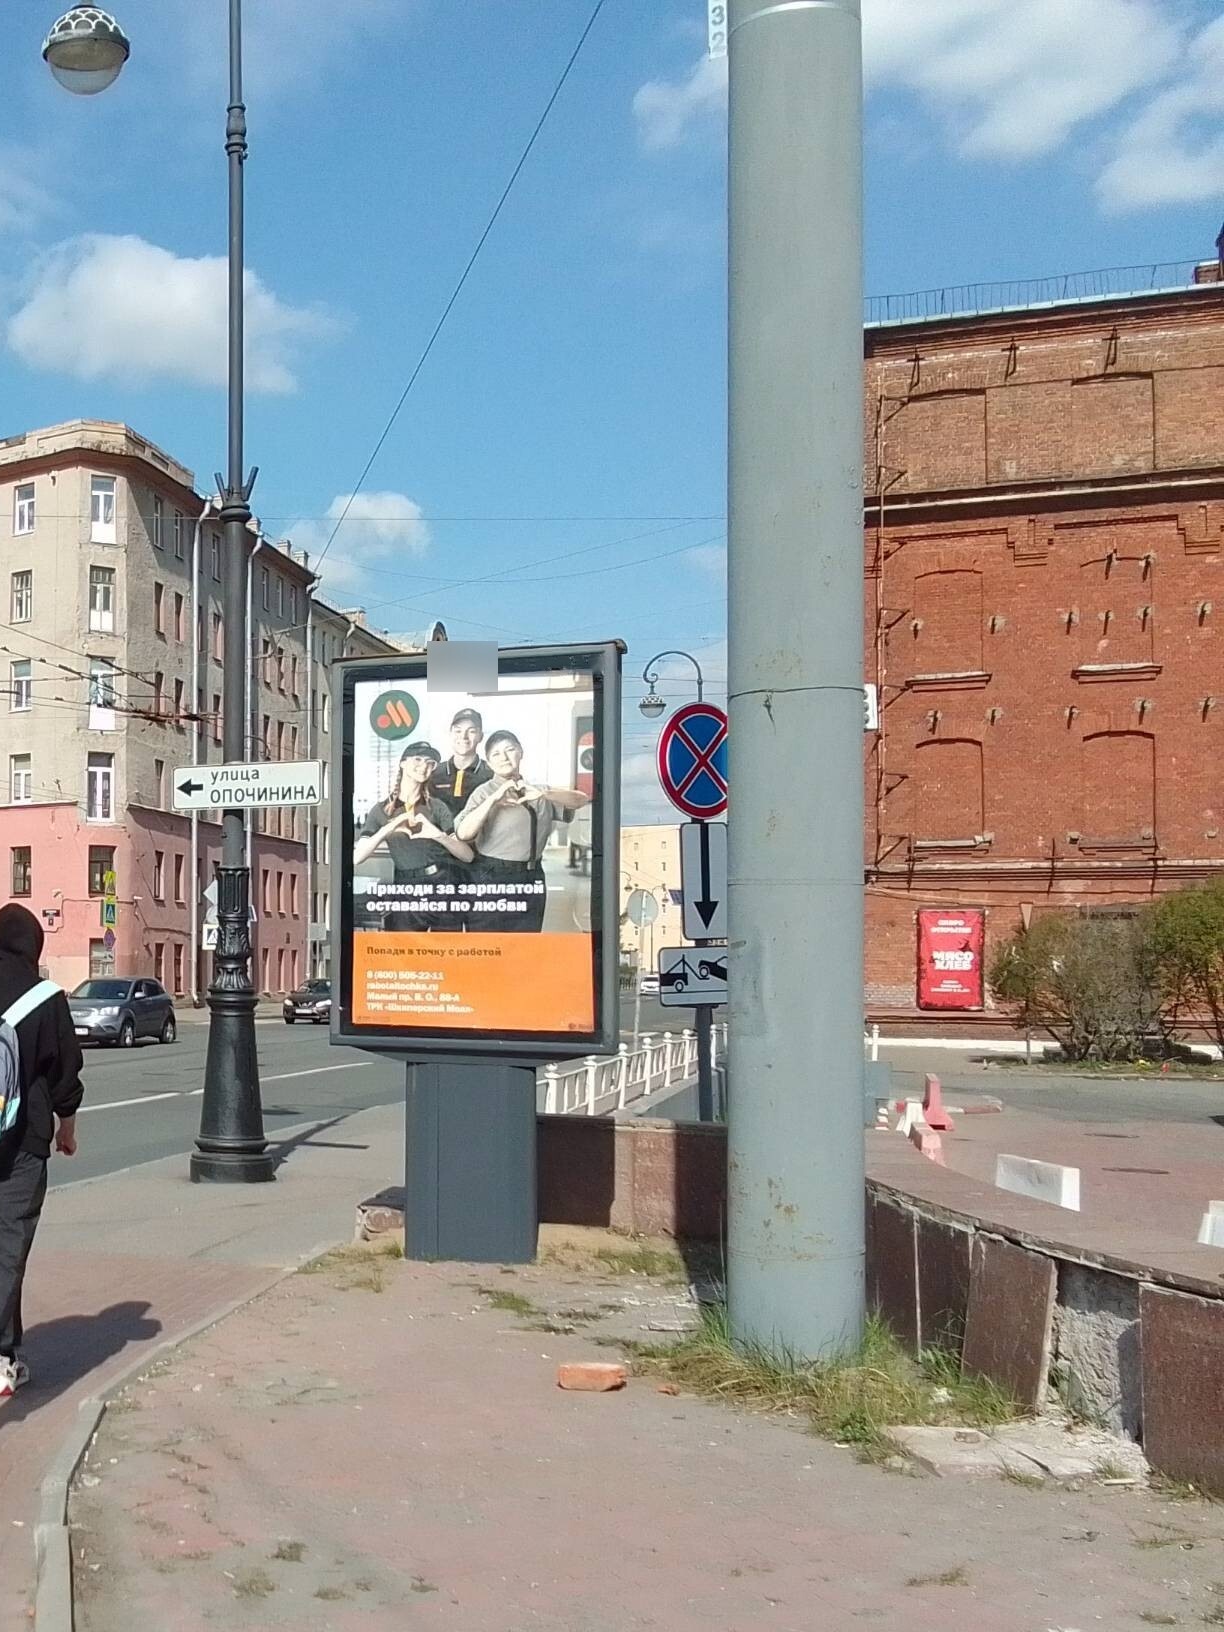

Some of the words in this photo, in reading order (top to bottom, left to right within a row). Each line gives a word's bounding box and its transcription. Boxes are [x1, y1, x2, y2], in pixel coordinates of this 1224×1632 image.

[210, 768, 260, 785] улица
[210, 784, 317, 804] ОПОЧИНИНА
[366, 882, 433, 897] Приходи
[436, 884, 455, 895] за
[458, 881, 544, 897] зарплатой
[366, 898, 447, 912] оставайся
[450, 901, 470, 912] по
[473, 898, 528, 912] любви
[366, 946, 405, 957] Попади
[416, 947, 445, 958] точку
[448, 948, 455, 956] с
[456, 946, 502, 957] работой
